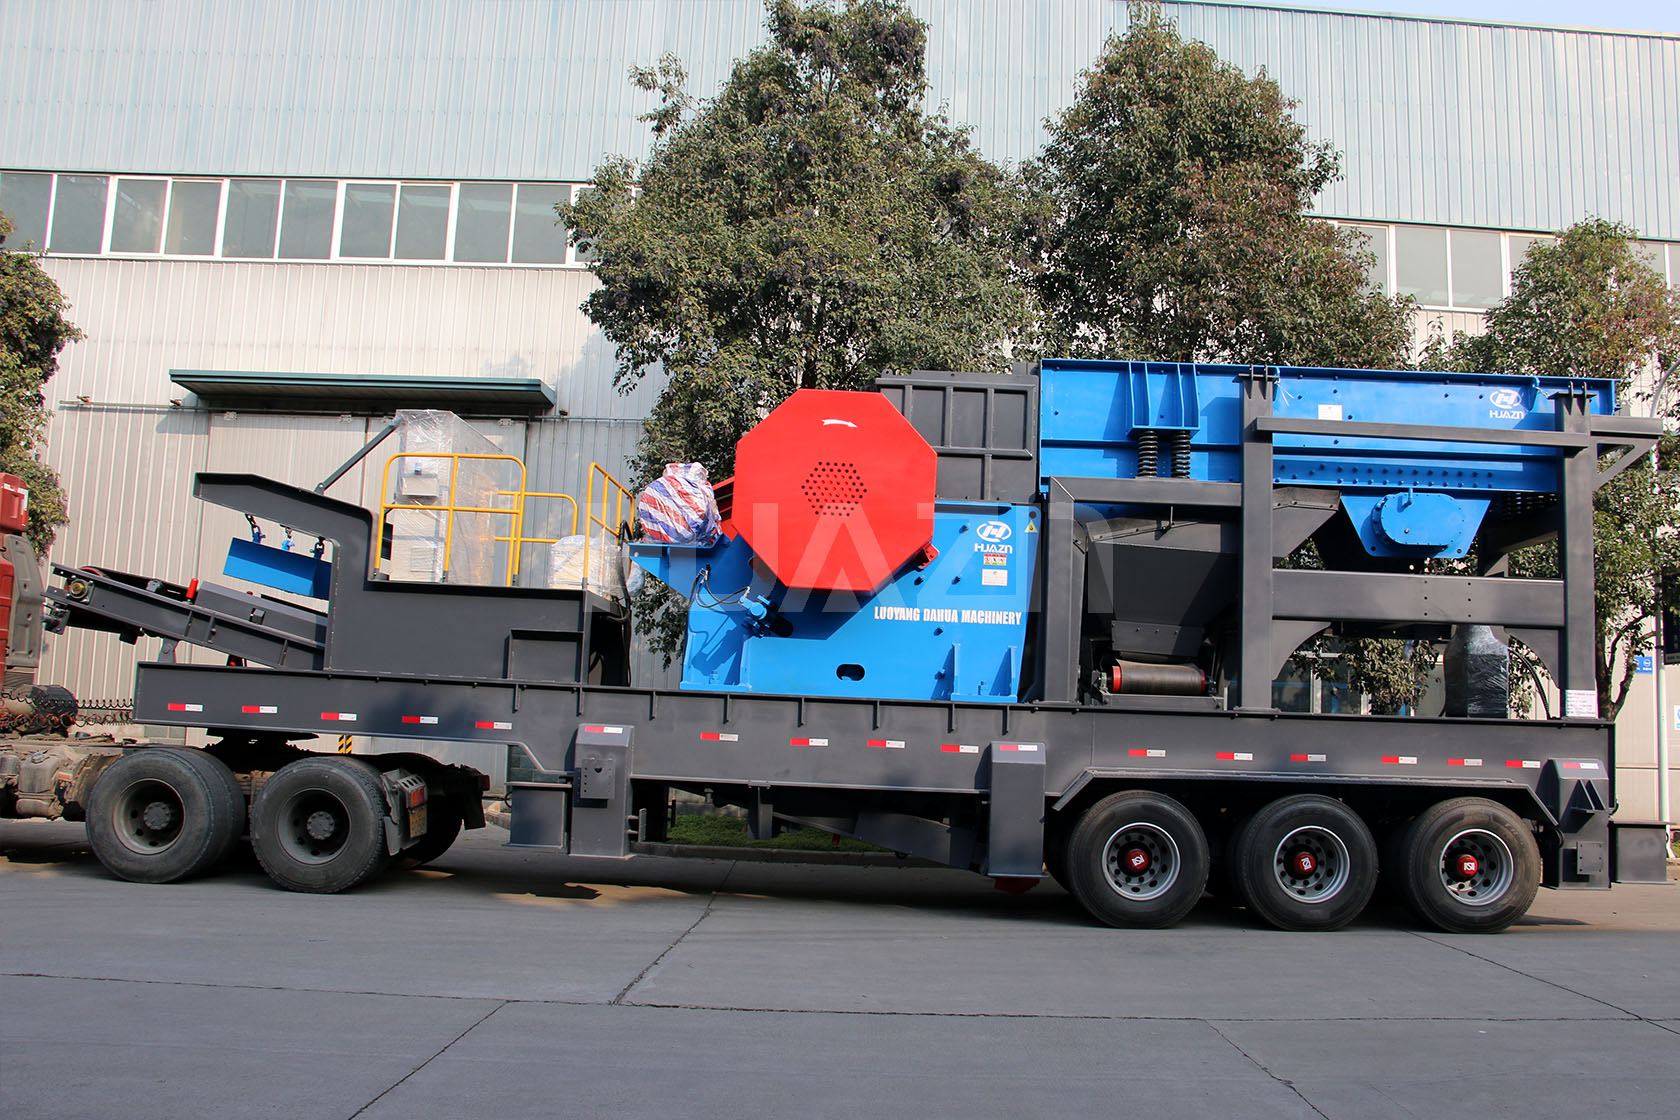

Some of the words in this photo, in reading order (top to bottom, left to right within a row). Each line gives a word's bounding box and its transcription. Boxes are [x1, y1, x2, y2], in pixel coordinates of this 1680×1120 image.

[874, 606, 920, 621] LUOYANG
[923, 608, 958, 623] DAHUA
[961, 609, 1022, 625] MACHINERY
